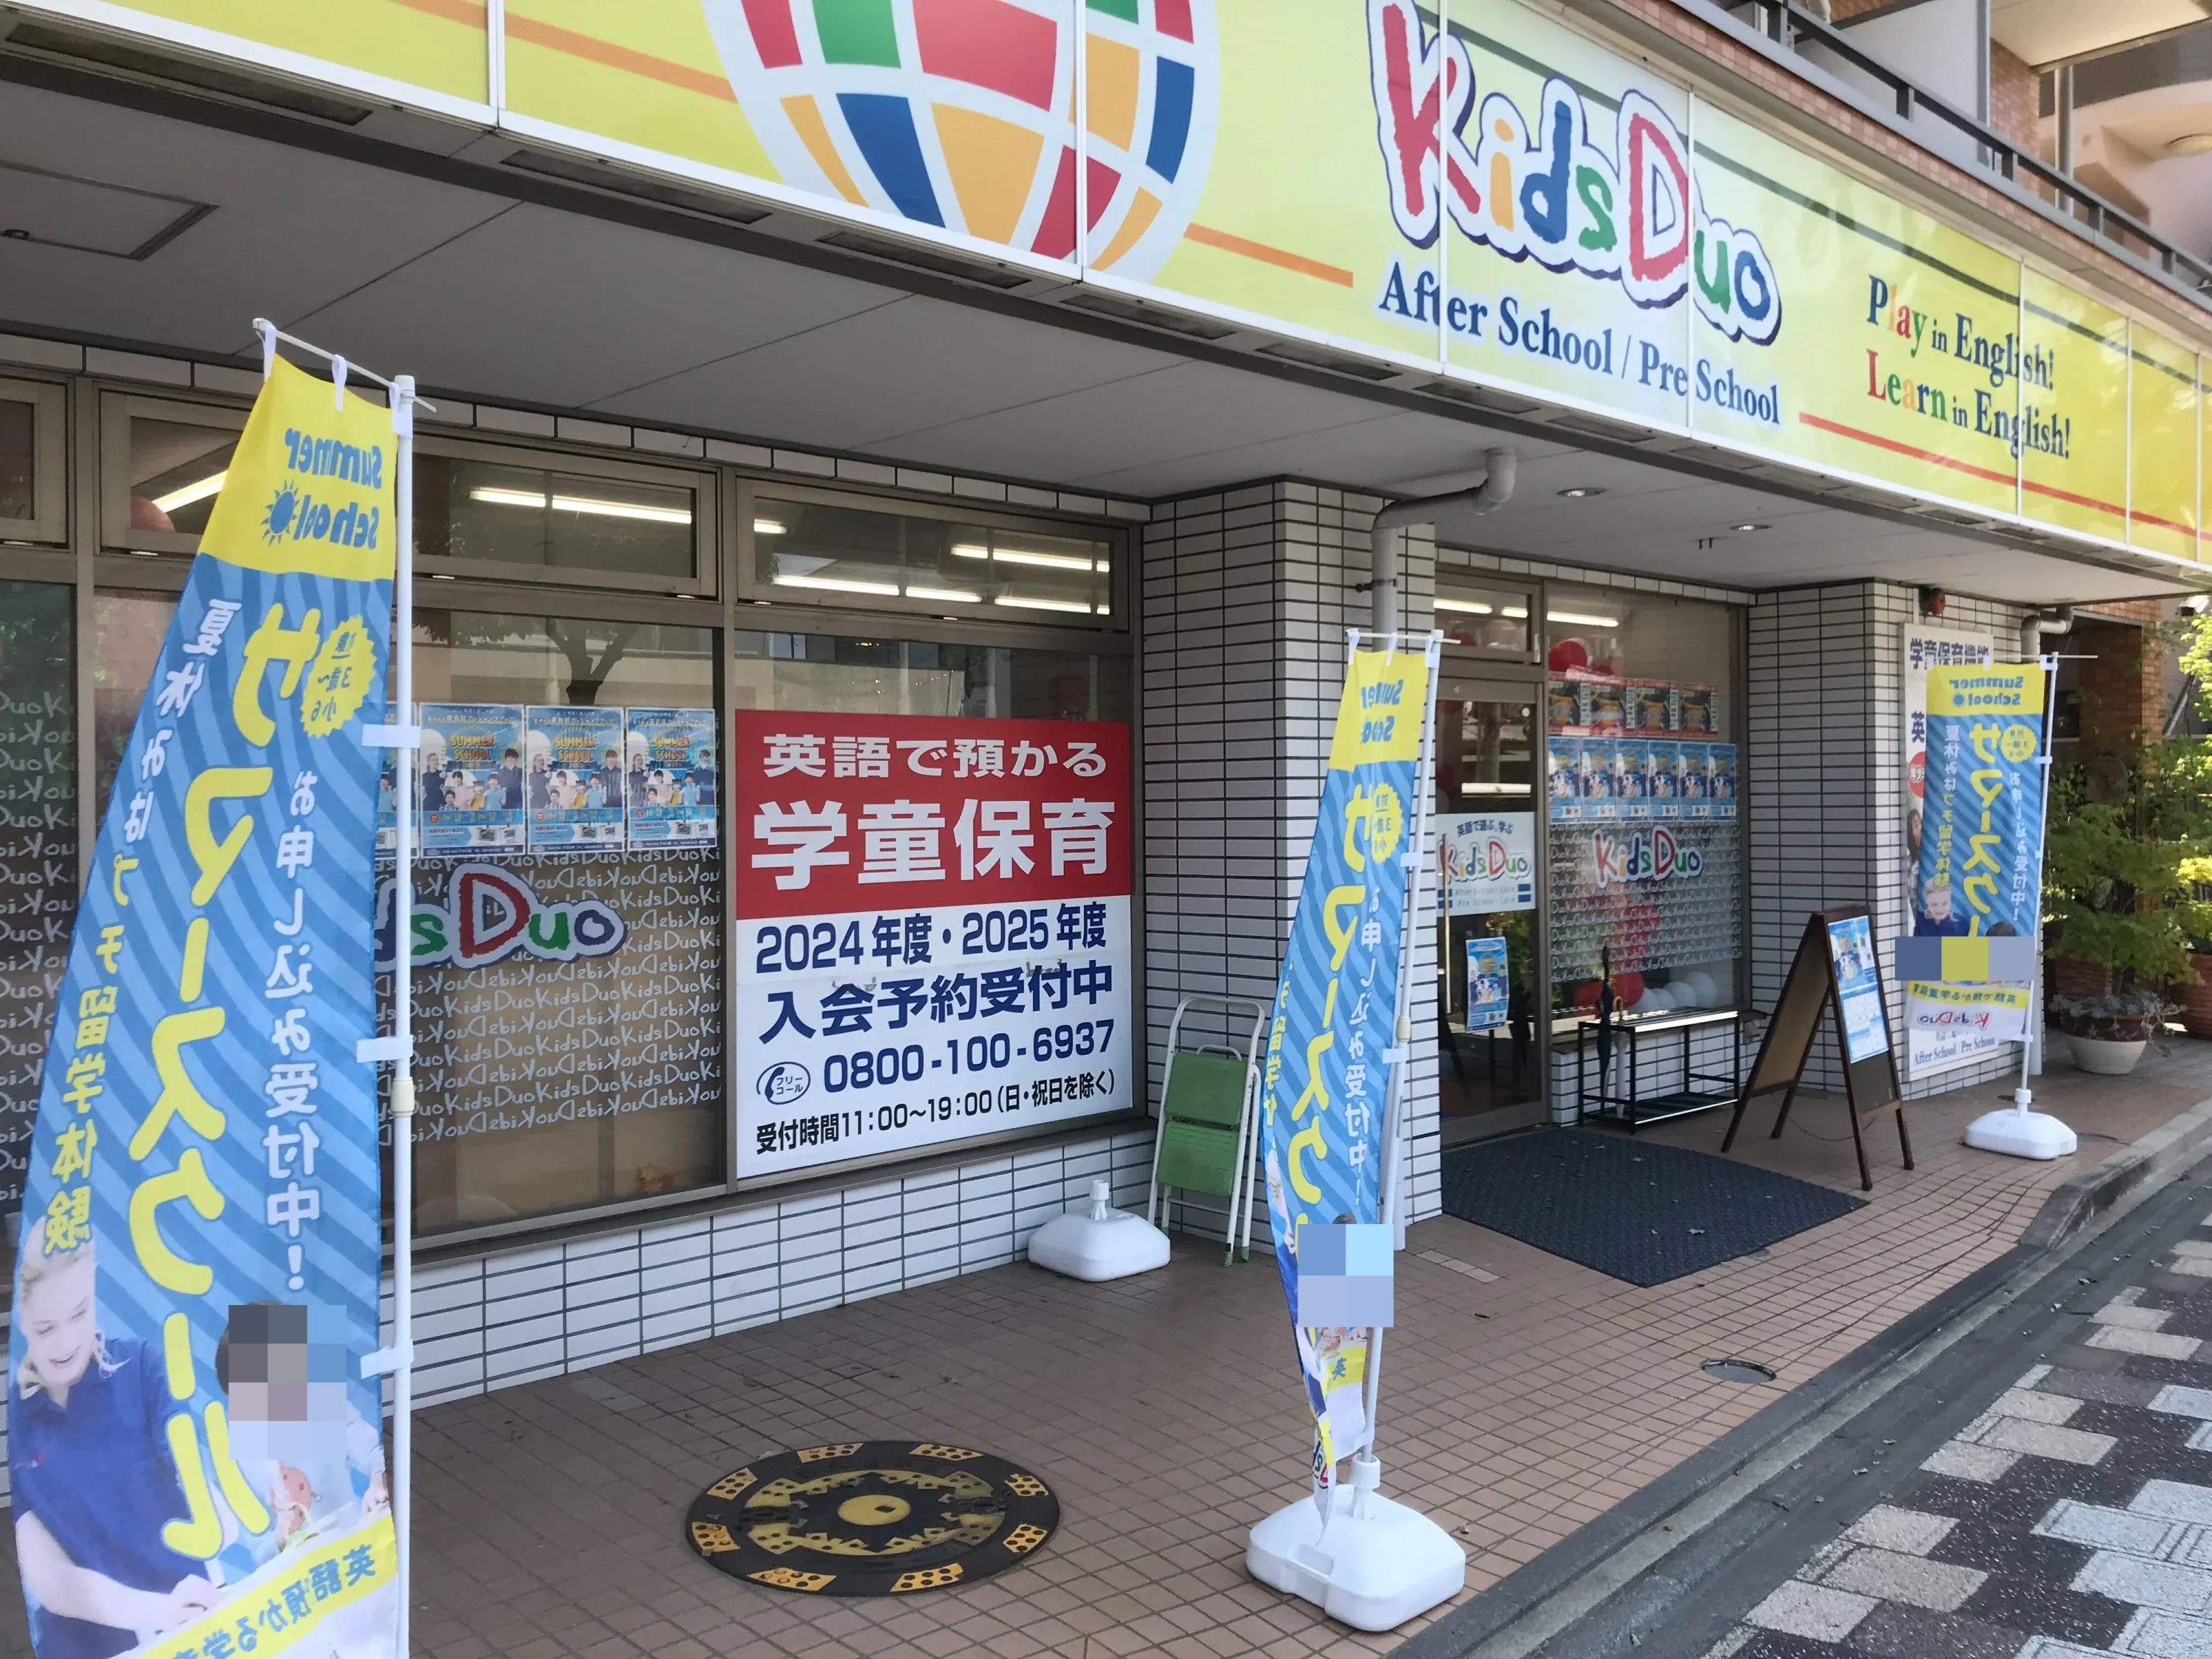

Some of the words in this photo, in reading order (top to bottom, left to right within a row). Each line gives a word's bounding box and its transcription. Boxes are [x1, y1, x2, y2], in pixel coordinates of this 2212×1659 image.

[1382, 3, 1770, 322] KidsDuo
[1379, 261, 1488, 337] After
[1498, 296, 1612, 376] School
[1638, 340, 1688, 396] Pre
[1696, 359, 1781, 425] School
[1866, 274, 1927, 357] Play
[1931, 319, 1947, 354] in
[1954, 313, 2054, 391] English!
[1866, 348, 1947, 422] Learn
[1952, 395, 1969, 428] in
[1974, 389, 2070, 459] English!
[763, 734, 1107, 779] 英語で預かる
[751, 798, 1115, 891] 学童保育
[1595, 830, 1701, 883] KidsDuo
[758, 960, 1113, 1045] 入会予約受付中
[776, 1075, 803, 1086] フリー
[776, 1083, 804, 1095] コール
[823, 1019, 1115, 1093] 0800-100-6937
